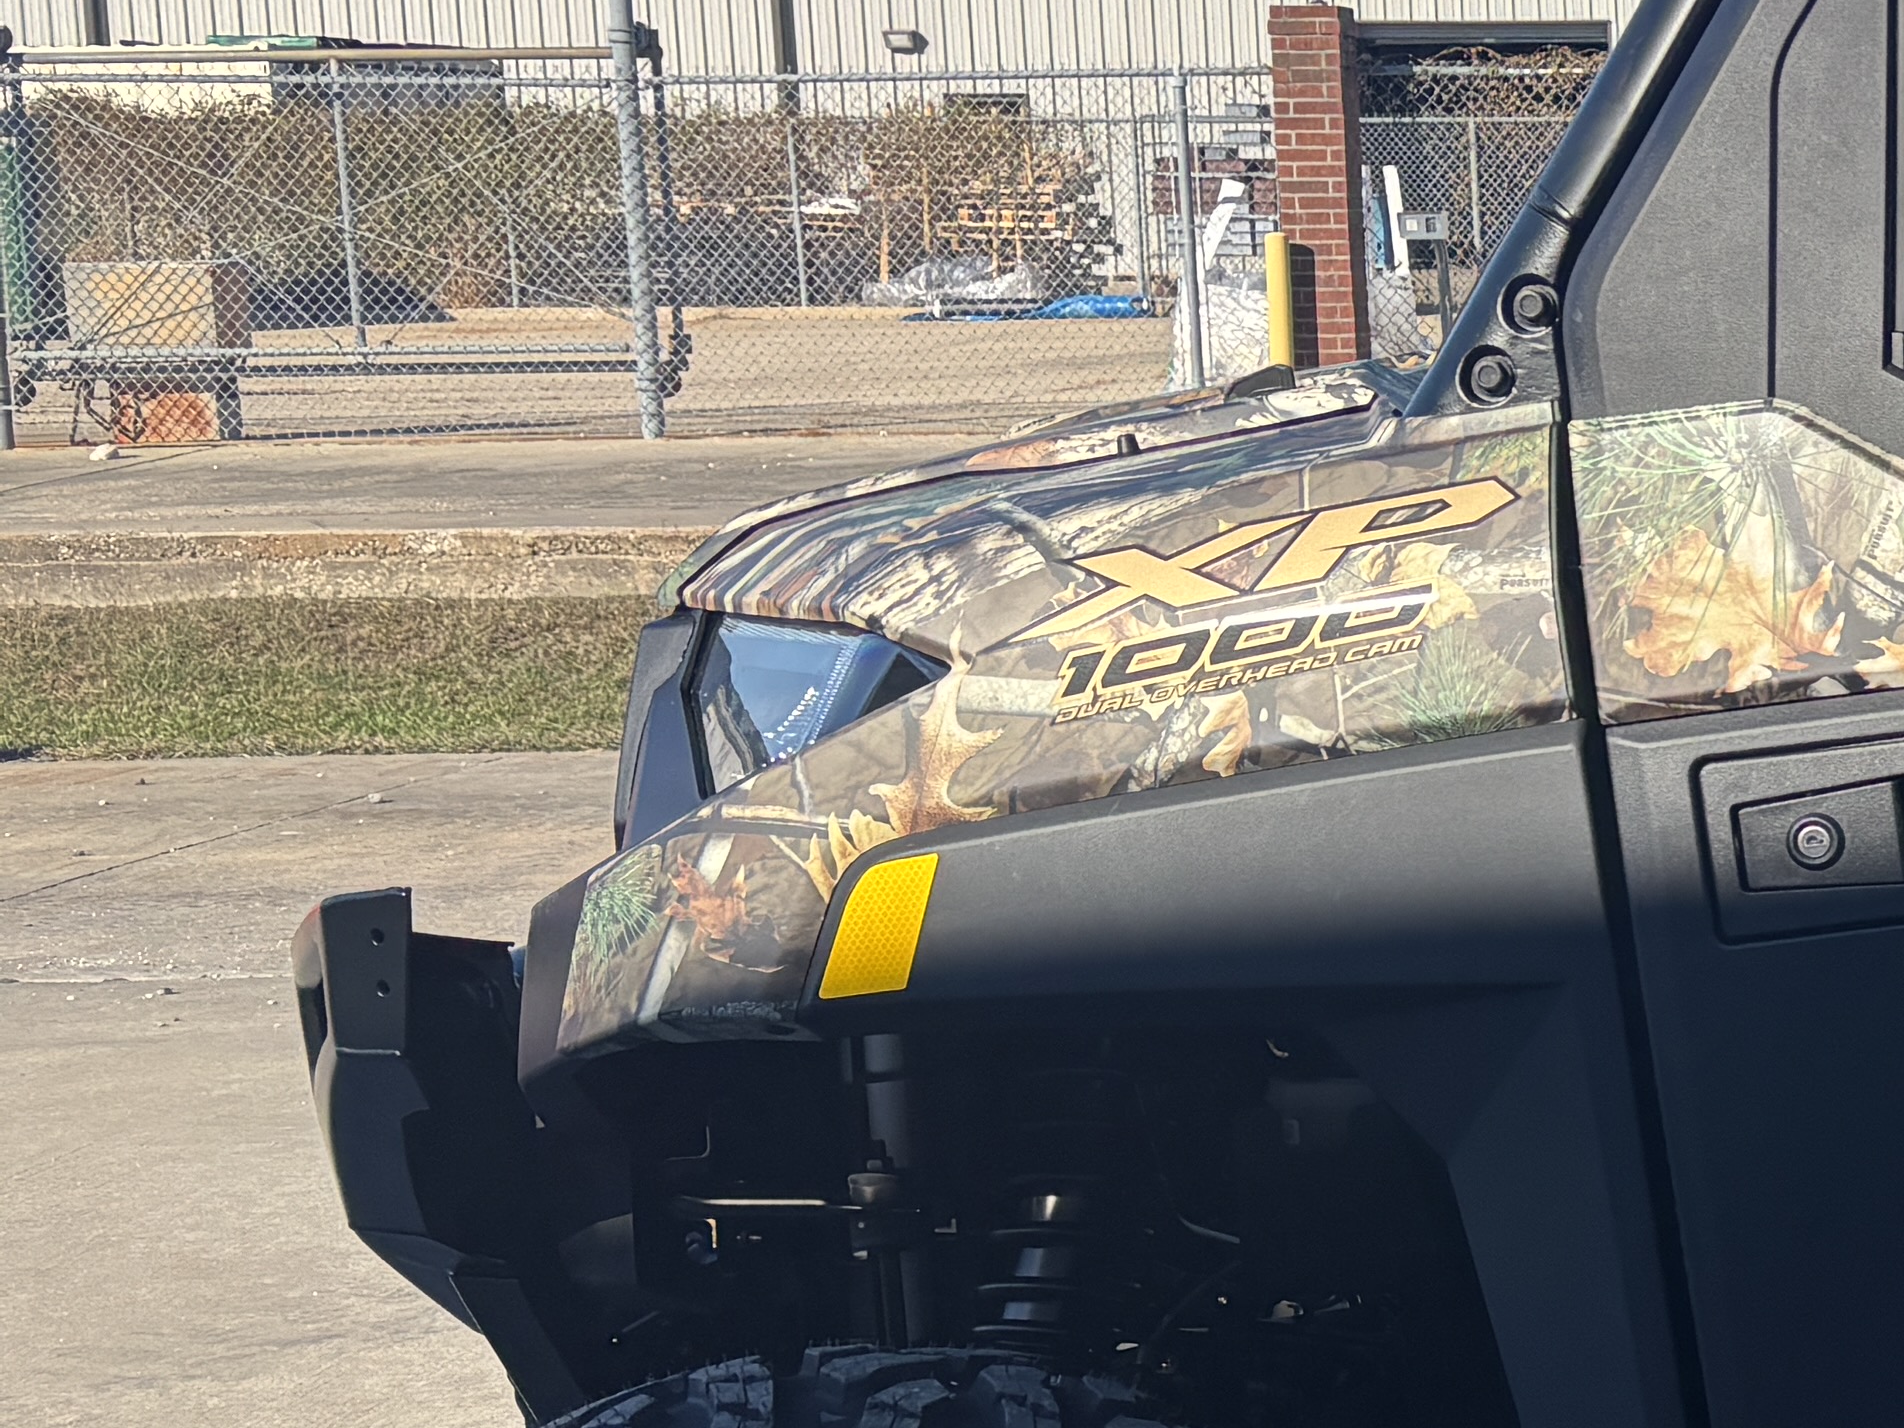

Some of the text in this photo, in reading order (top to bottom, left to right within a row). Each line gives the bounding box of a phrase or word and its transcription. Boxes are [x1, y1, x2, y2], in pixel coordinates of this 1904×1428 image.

[992, 475, 1521, 649] XP
[1050, 578, 1440, 706] 1000
[1051, 634, 1425, 725] DUAL OVERHEAD CAM
